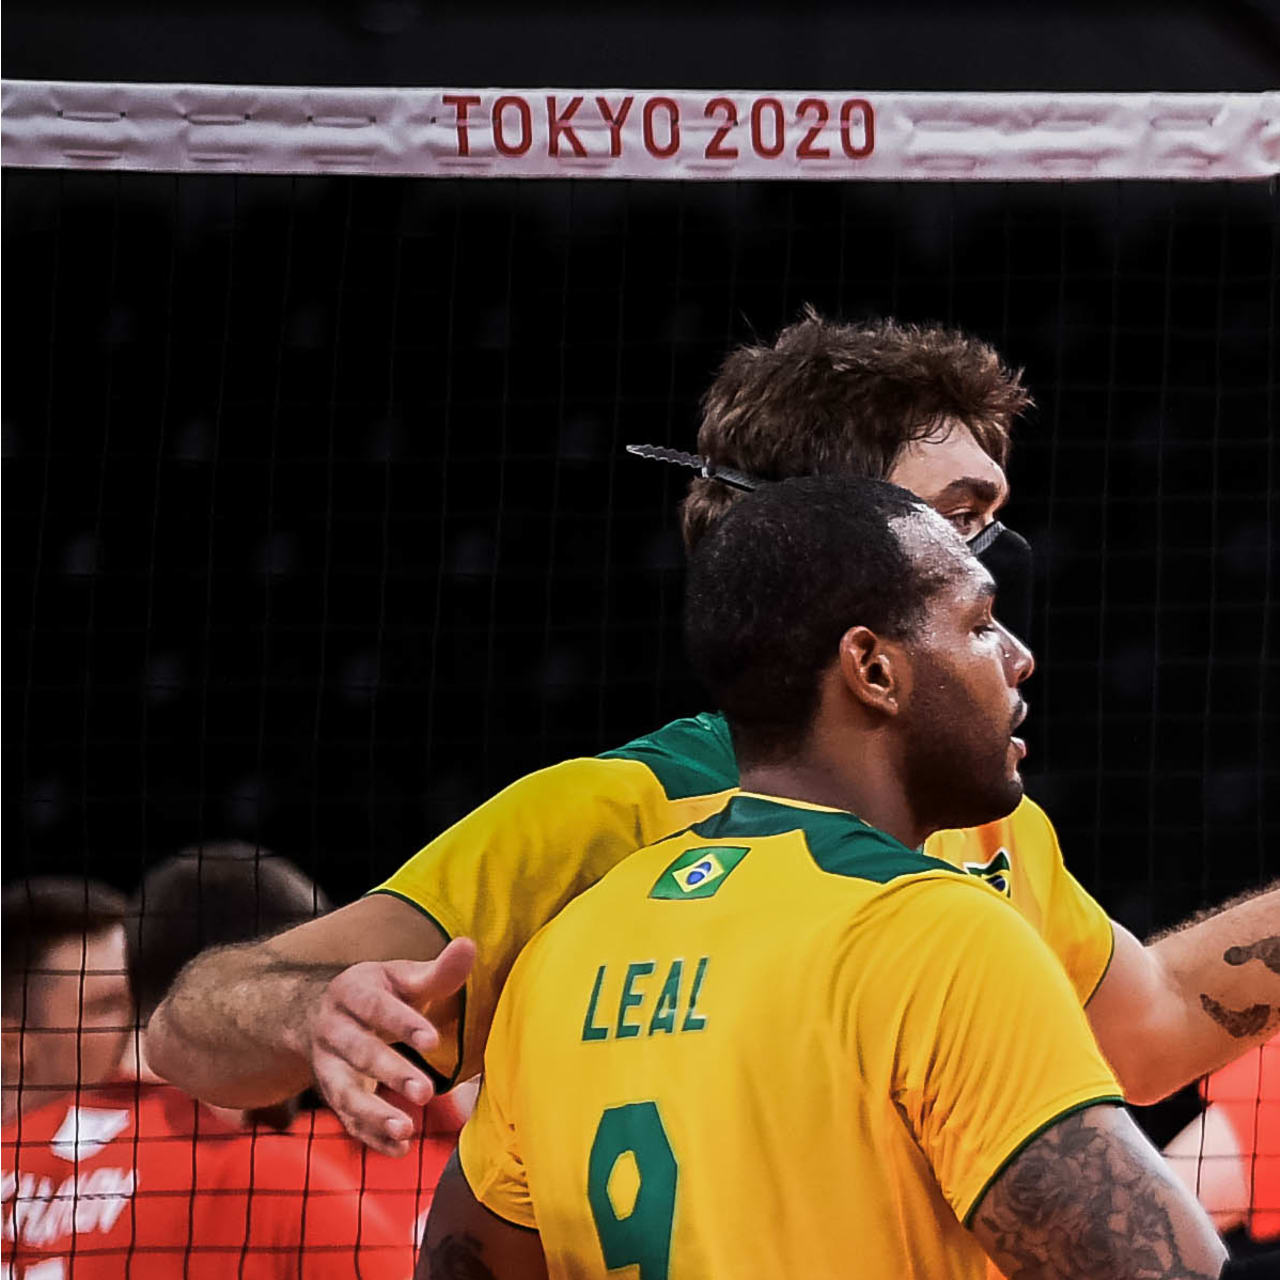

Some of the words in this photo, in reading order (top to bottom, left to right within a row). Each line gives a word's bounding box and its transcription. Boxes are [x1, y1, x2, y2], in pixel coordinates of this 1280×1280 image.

[442, 95, 681, 159] TOKYO
[703, 96, 876, 160] 2020
[581, 956, 710, 1042] LEAL
